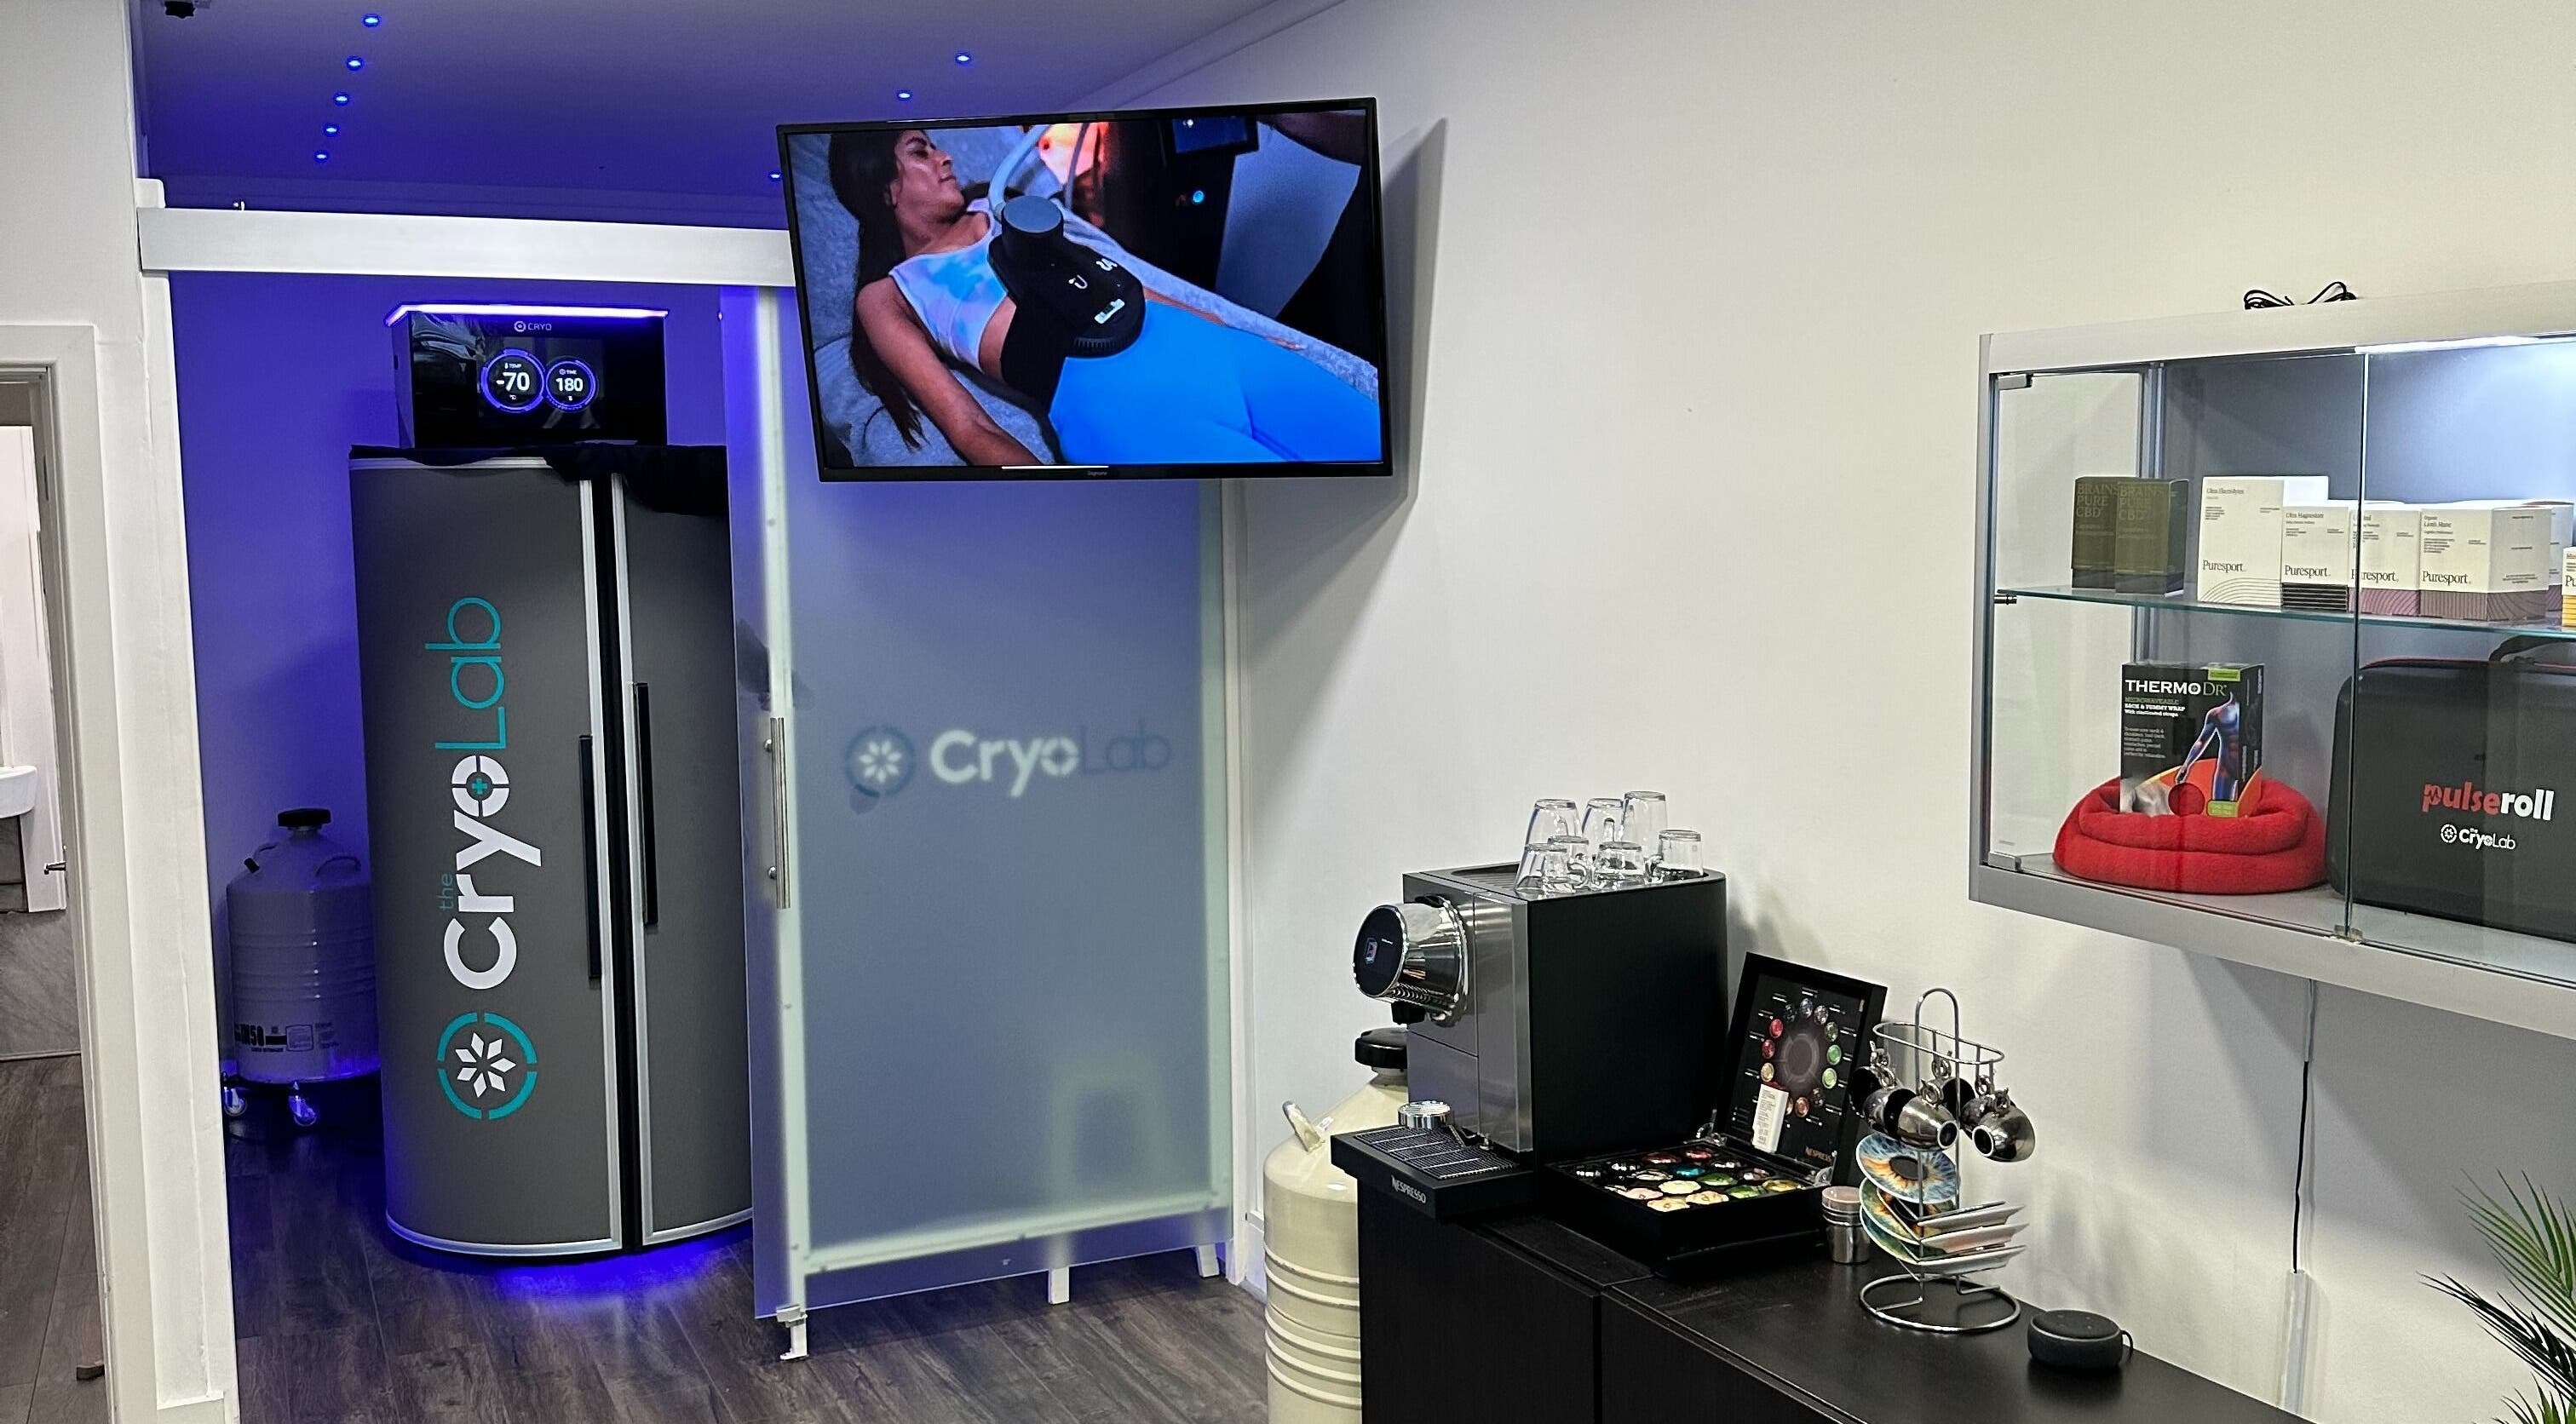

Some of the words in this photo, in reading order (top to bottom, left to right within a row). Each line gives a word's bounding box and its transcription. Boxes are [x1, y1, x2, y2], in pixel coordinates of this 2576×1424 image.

[527, 322, 553, 331] CRYO
[496, 371, 530, 392] -70
[556, 377, 584, 392] 180
[2077, 495, 2108, 507] PURE
[2076, 506, 2102, 518] CBD
[2421, 780, 2555, 821] pulseroll
[1390, 1174, 1427, 1203] NESPRESSO
